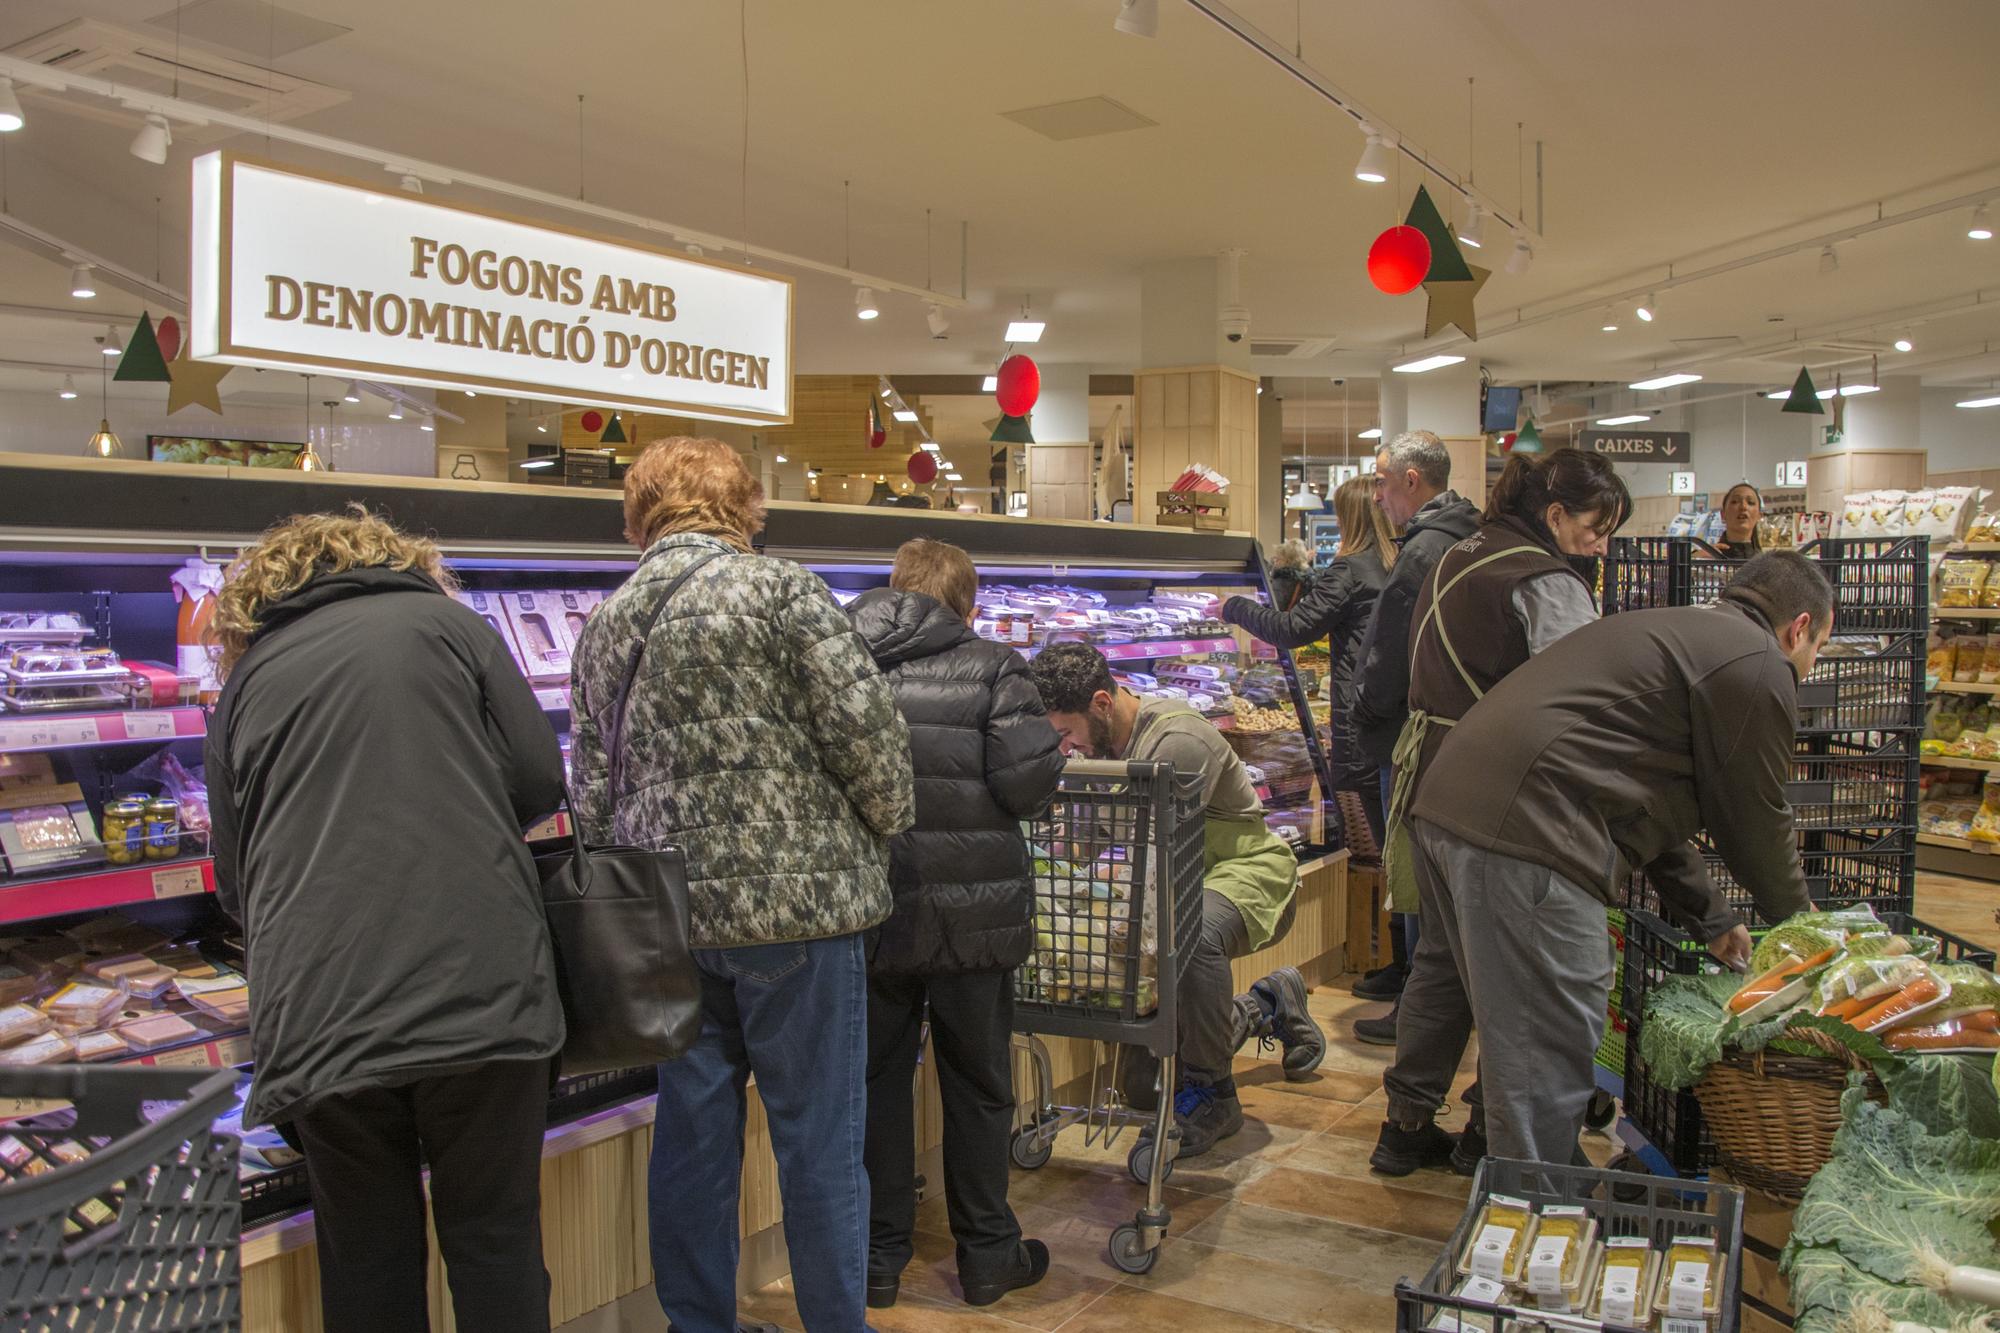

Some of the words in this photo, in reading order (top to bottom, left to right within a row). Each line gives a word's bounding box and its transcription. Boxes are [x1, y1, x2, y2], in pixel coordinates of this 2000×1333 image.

[410, 236, 584, 306] FOGONS
[590, 274, 677, 322] AMB
[264, 274, 595, 364] DENOMINACIÓ
[603, 331, 770, 391] D'ORIGEN
[1594, 438, 1654, 453] CAIXES
[1793, 466, 1804, 480] 4
[1679, 476, 1689, 489] 3
